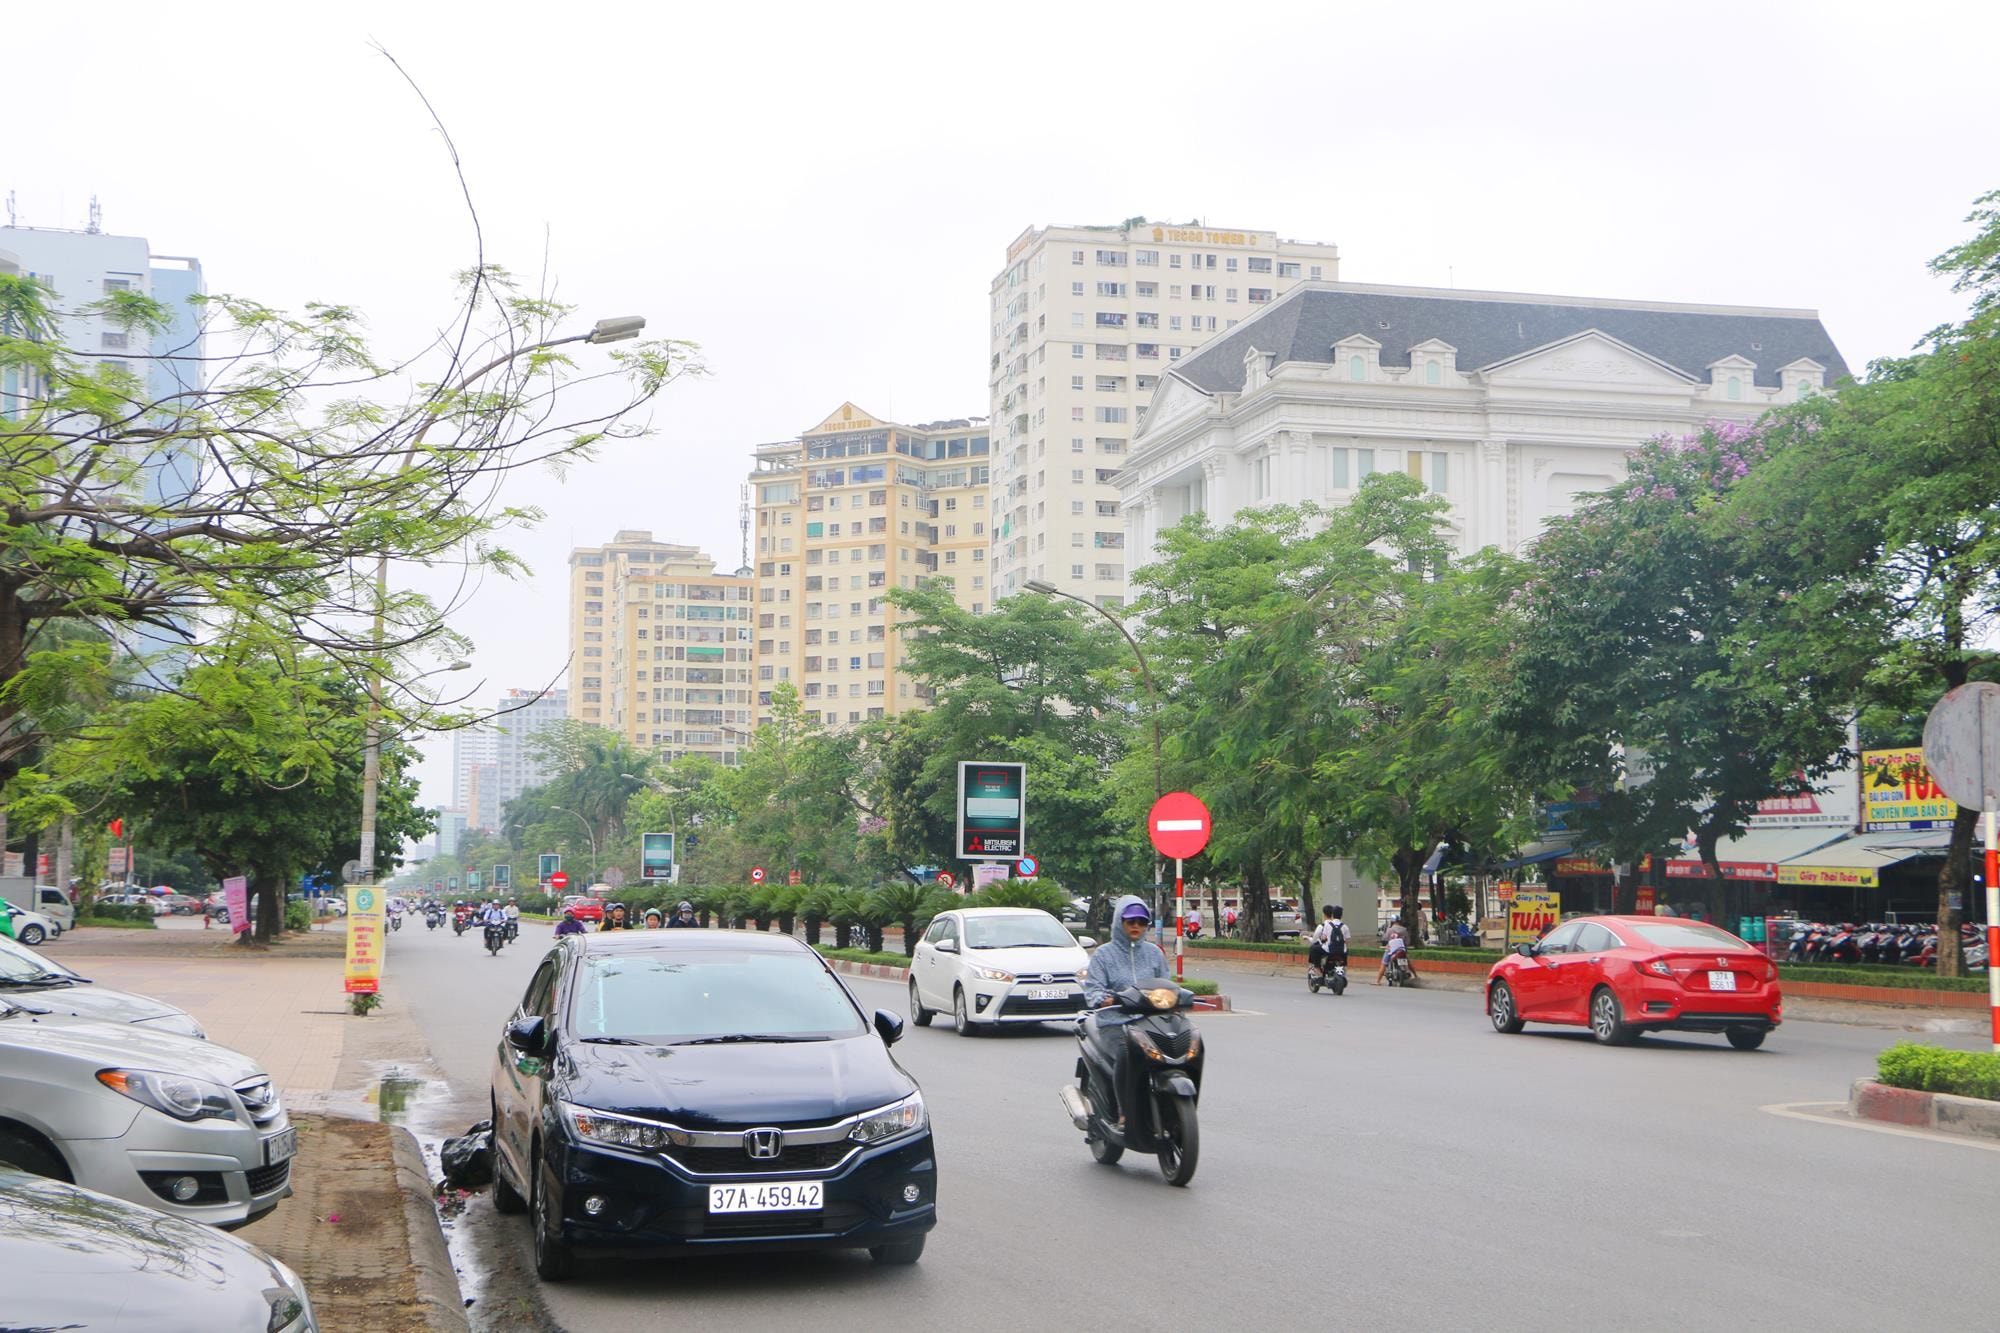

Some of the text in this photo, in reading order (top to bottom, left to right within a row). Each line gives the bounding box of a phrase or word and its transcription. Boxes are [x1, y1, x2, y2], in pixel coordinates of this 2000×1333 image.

[1168, 230, 1257, 245] TECCO TOWER C
[1902, 805, 1919, 818] MUA
[984, 839, 1016, 847] MITSUBISHI
[713, 1185, 820, 1210] 37A-459.42
